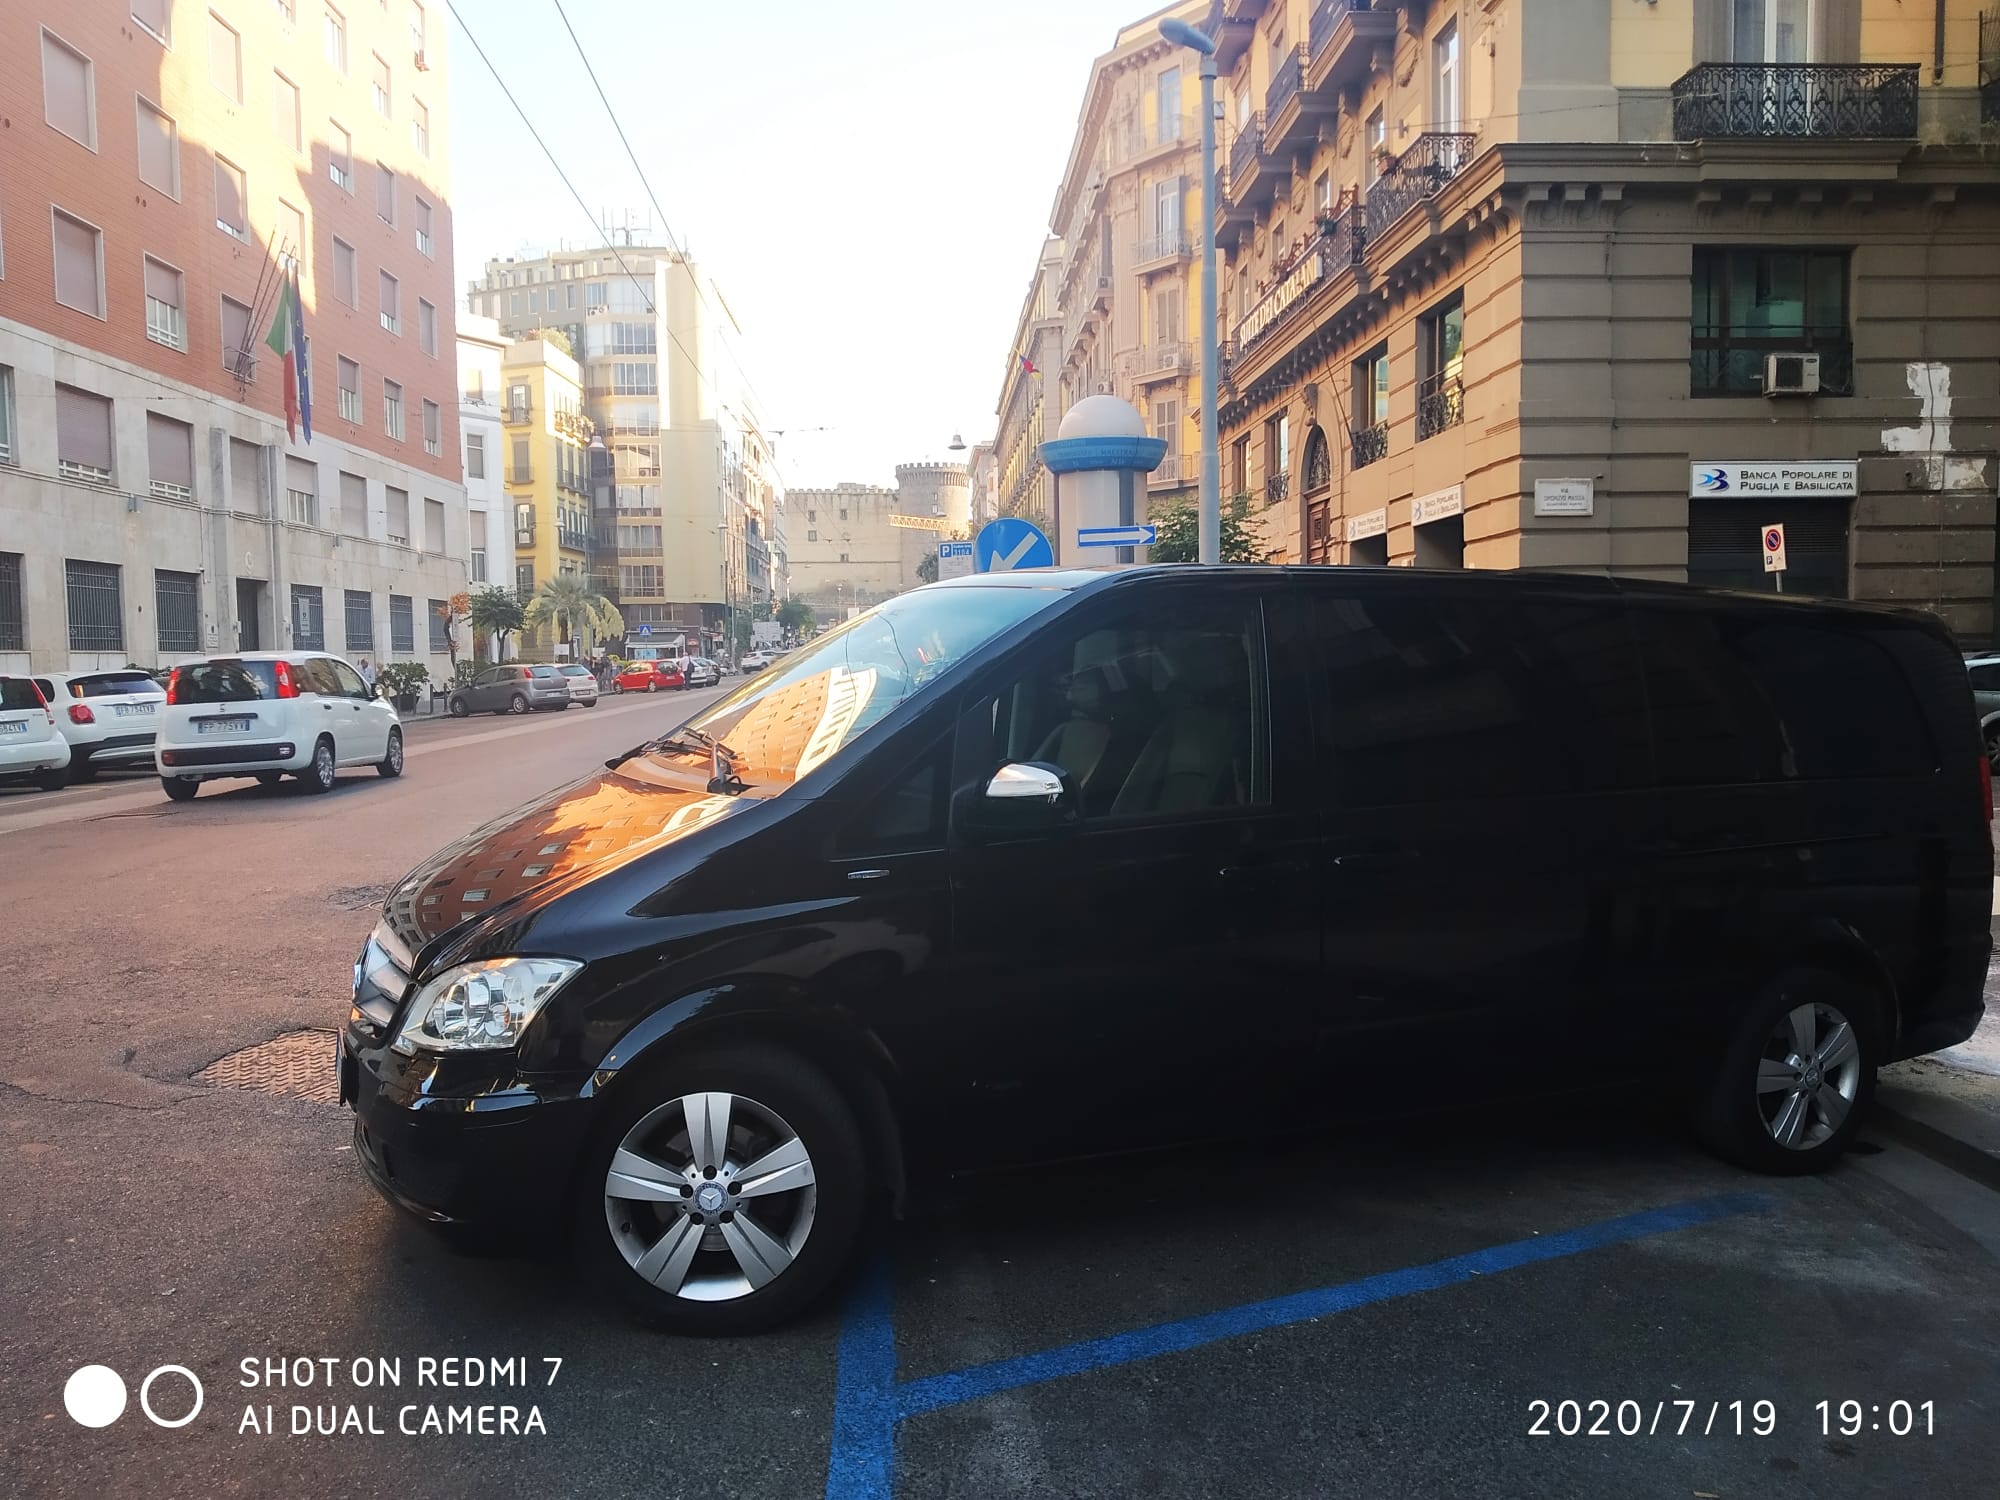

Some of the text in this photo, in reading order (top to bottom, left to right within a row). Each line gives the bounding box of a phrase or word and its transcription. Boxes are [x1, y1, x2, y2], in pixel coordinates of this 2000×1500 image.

[1240, 252, 1318, 351] SUITE DEI CATALANI
[1740, 470, 1853, 480] BANCA POPOLARE DI
[1740, 481, 1854, 491] PUGLIA E BASILICATA
[942, 545, 950, 557] P
